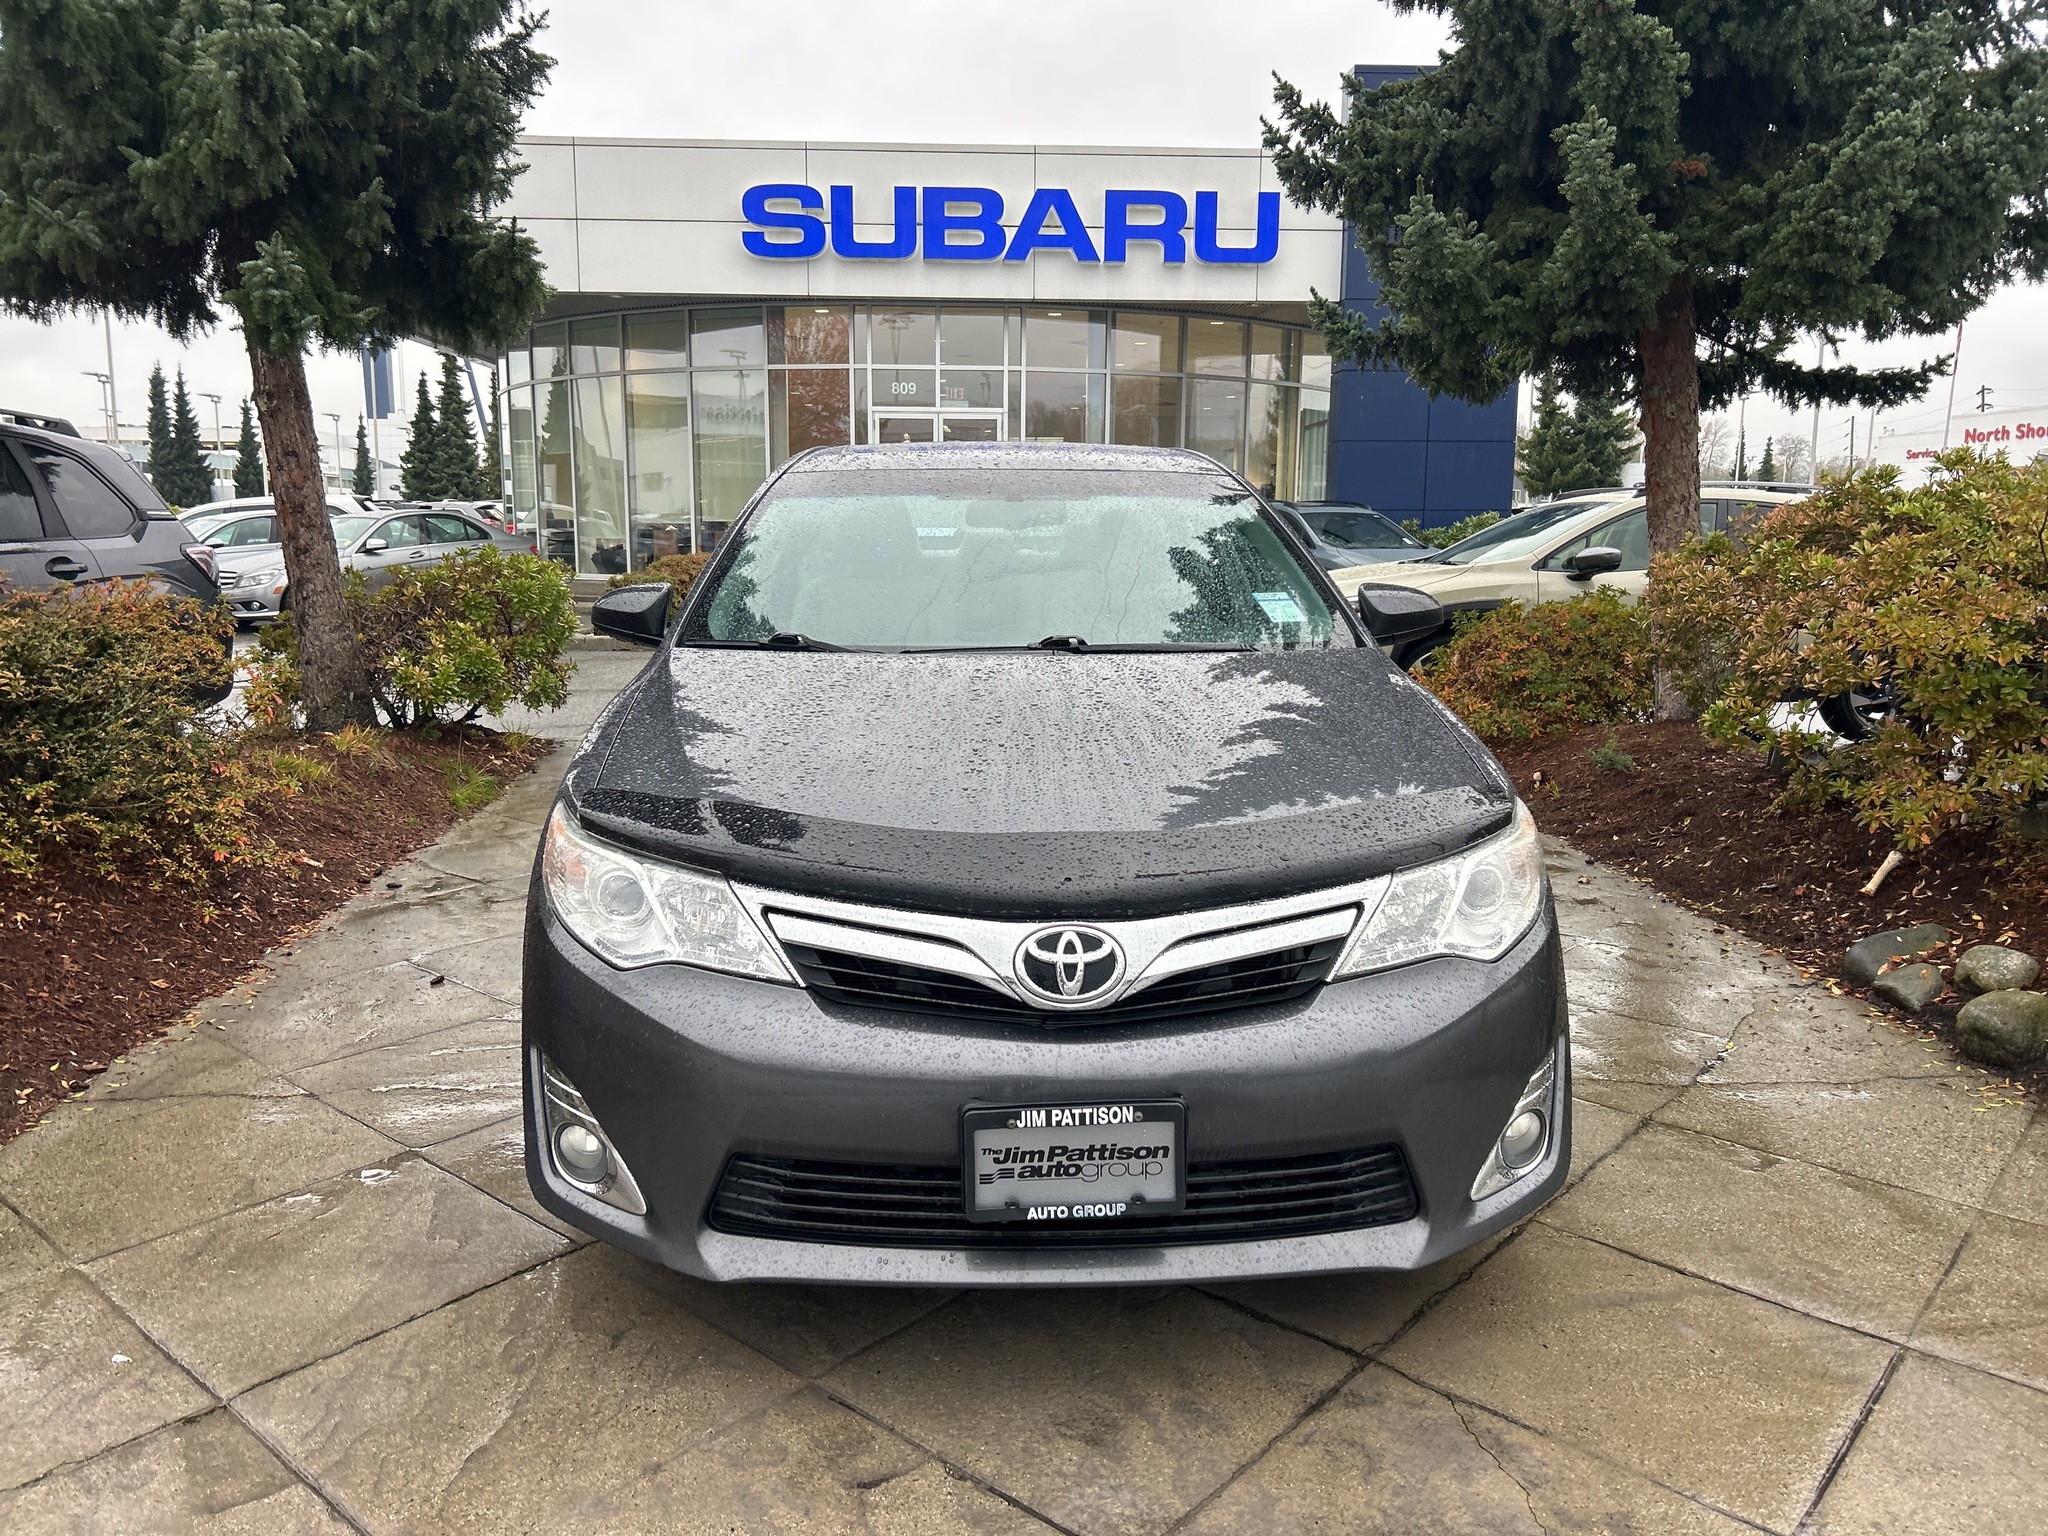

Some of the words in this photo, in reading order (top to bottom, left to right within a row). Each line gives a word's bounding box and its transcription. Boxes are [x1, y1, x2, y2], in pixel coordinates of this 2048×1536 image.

[742, 184, 1281, 264] SUBARU
[891, 382, 917, 395] 809
[1964, 425, 2010, 444] North
[2015, 423, 2048, 440] Sho
[1016, 1110, 1046, 1128] JIM
[1051, 1106, 1134, 1126] PATTISON
[981, 1147, 1003, 1156] The
[992, 1147, 1045, 1165] Jim
[1047, 1143, 1170, 1163] Pattison
[1027, 1205, 1069, 1220] AUTO
[1072, 1203, 1127, 1217] GROUP
